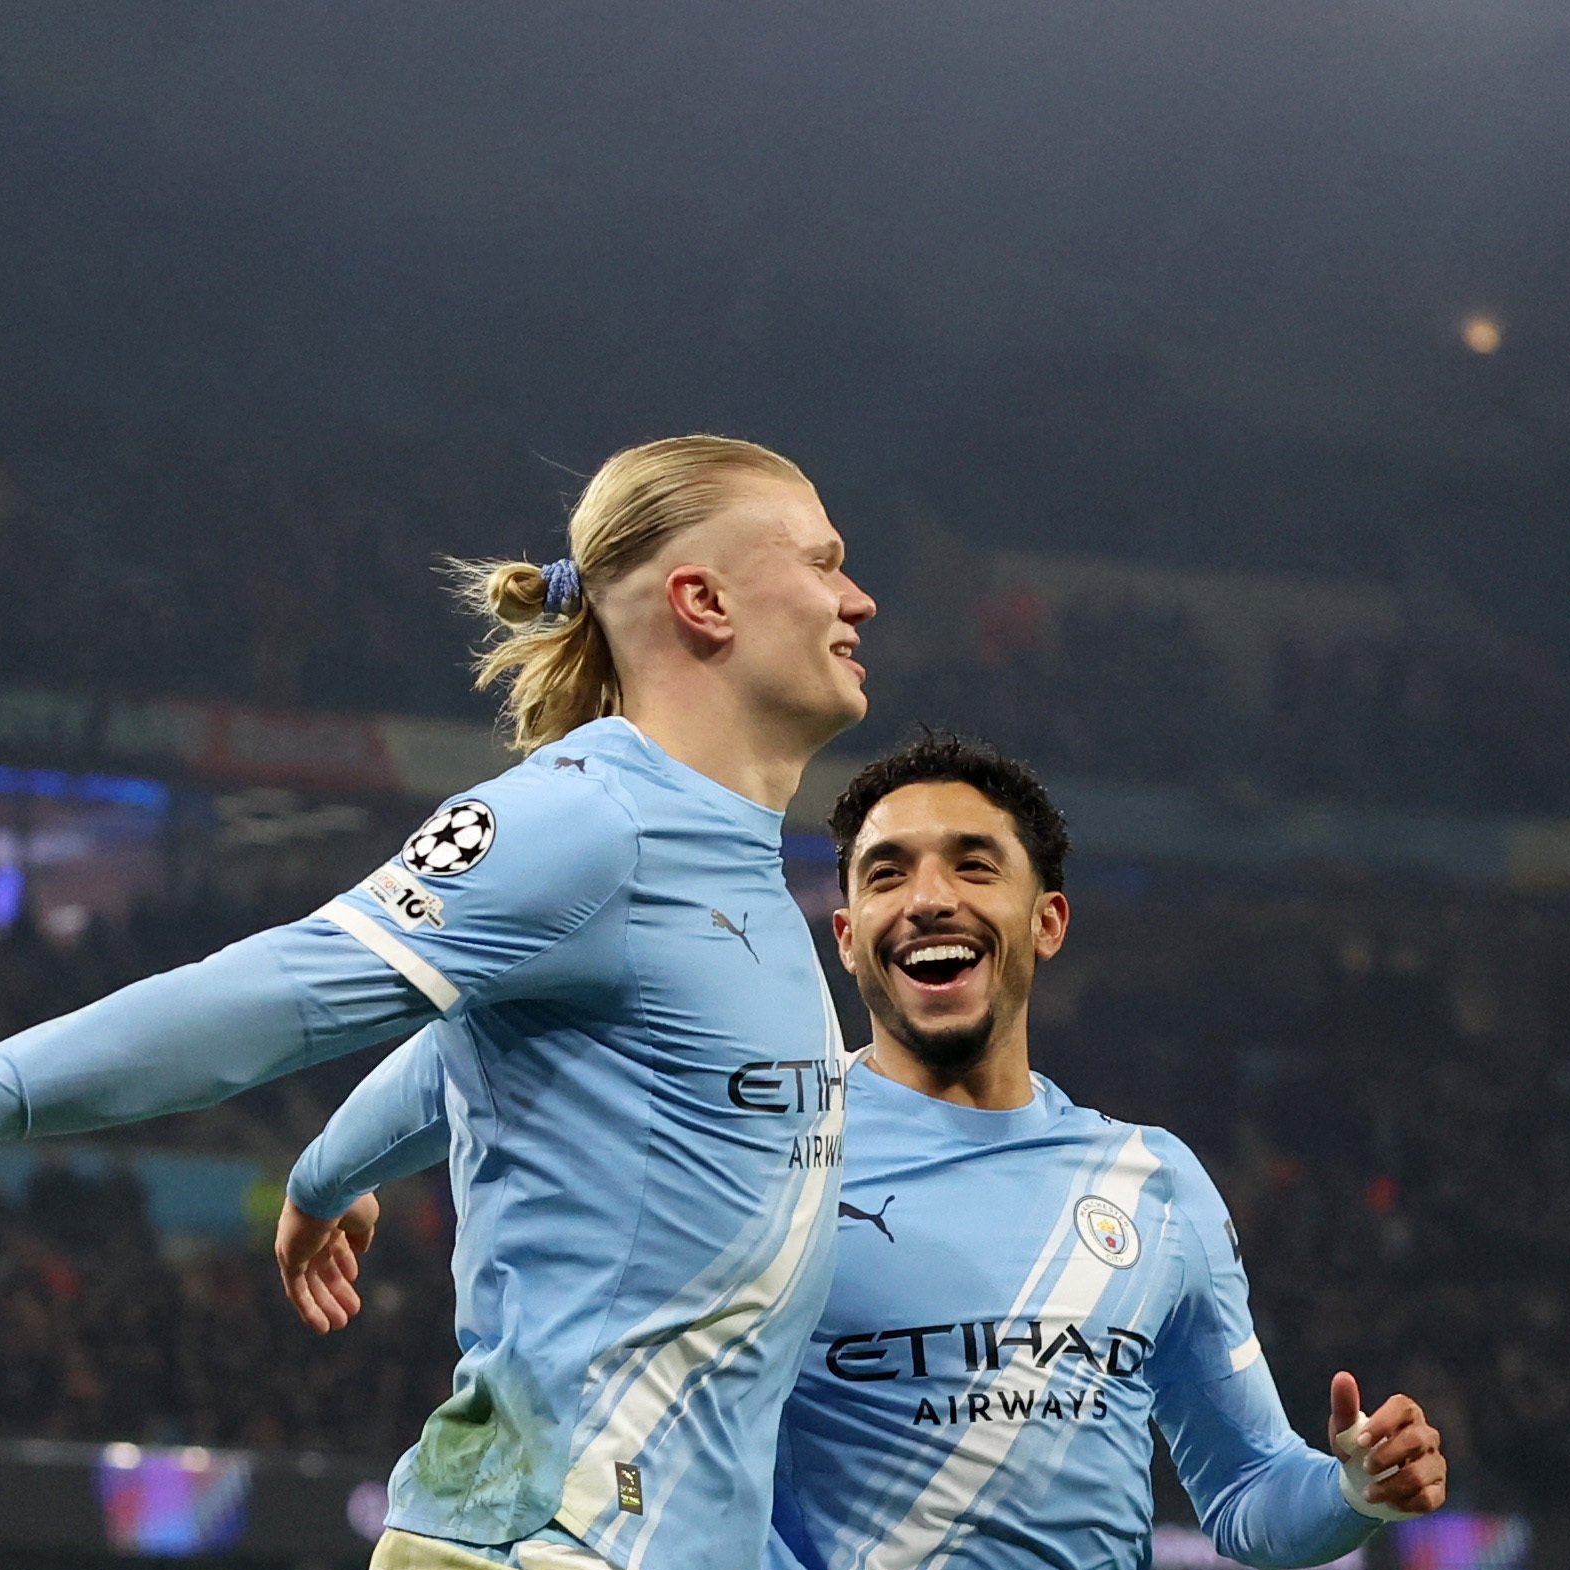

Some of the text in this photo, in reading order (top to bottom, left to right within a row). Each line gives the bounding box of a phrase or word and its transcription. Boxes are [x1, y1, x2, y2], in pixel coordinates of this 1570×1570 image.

[728, 1059, 846, 1114] ETIH
[1079, 1200, 1130, 1228] MANCHESTER
[1106, 1254, 1124, 1264] CITY
[826, 1320, 1155, 1382] ETIHAD
[913, 1389, 1108, 1426] AIRWAYS
